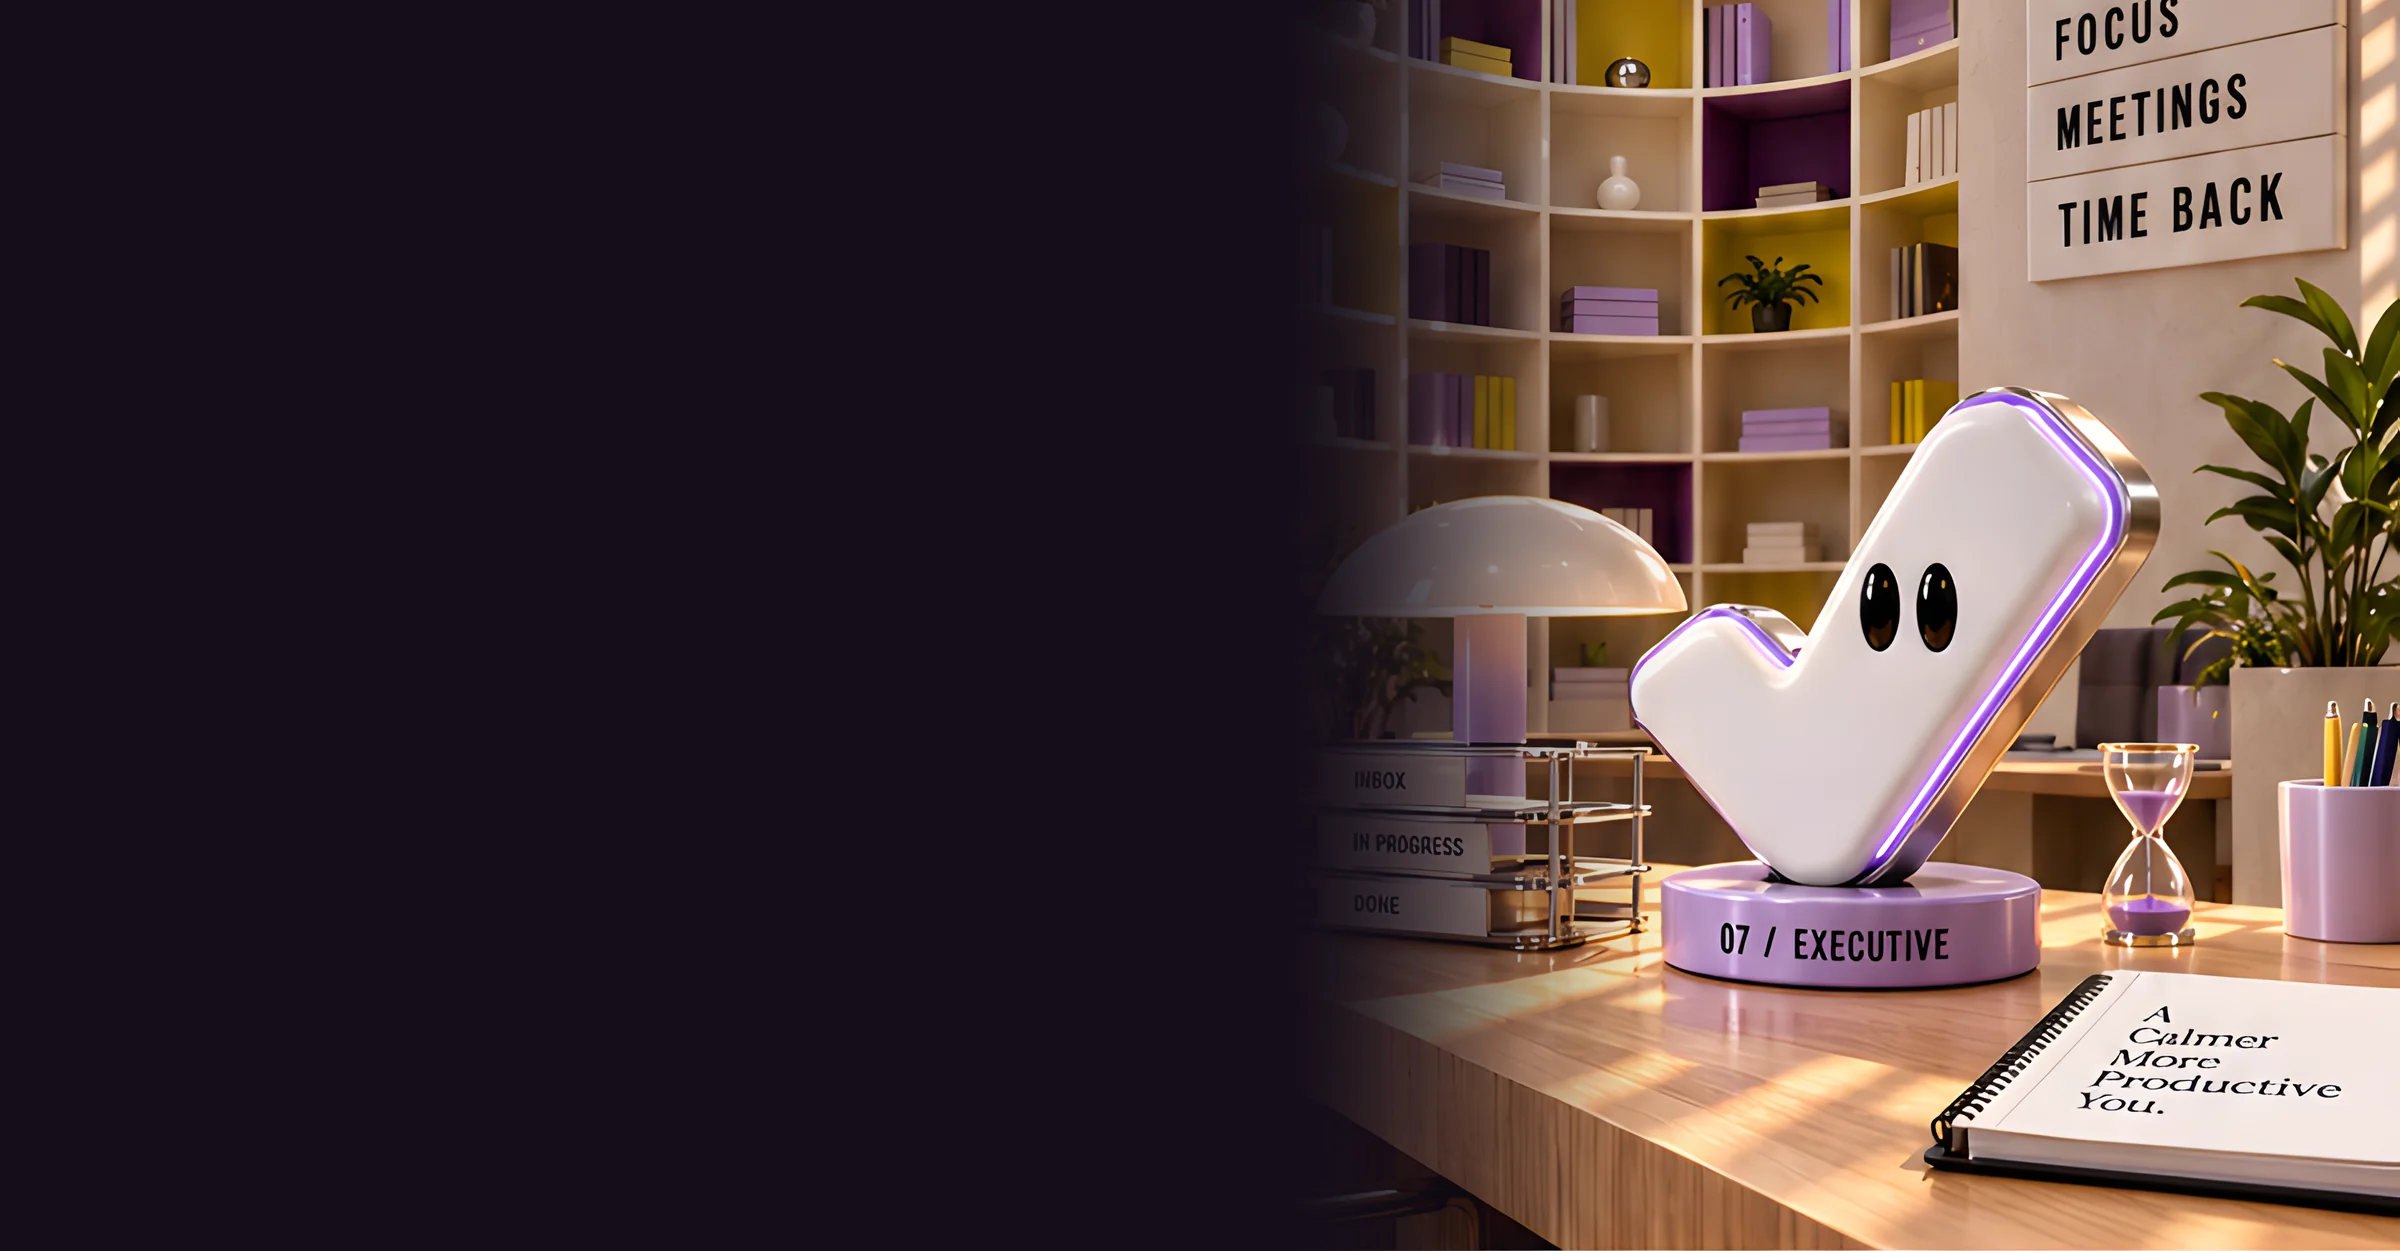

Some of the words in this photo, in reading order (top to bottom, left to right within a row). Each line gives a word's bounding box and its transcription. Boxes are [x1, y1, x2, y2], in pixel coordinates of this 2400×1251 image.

[2055, 0, 2179, 61] FOCUS
[2057, 73, 2247, 151] MEETINGS
[2058, 191, 2148, 247] TIME
[2173, 172, 2284, 233] BACK
[1355, 771, 1406, 790] INBOX
[1353, 833, 1370, 851] IN
[1376, 834, 1464, 856] PROGRESS
[1720, 922, 1750, 955] 07
[1764, 926, 1777, 958] /
[1794, 928, 1950, 962] EXECUTIVE
[2143, 1005, 2171, 1023] A
[2129, 1027, 2279, 1049] Calmer
[2109, 1049, 2221, 1069] More
[2091, 1070, 2342, 1098] Productive
[2077, 1091, 2164, 1114] You.
